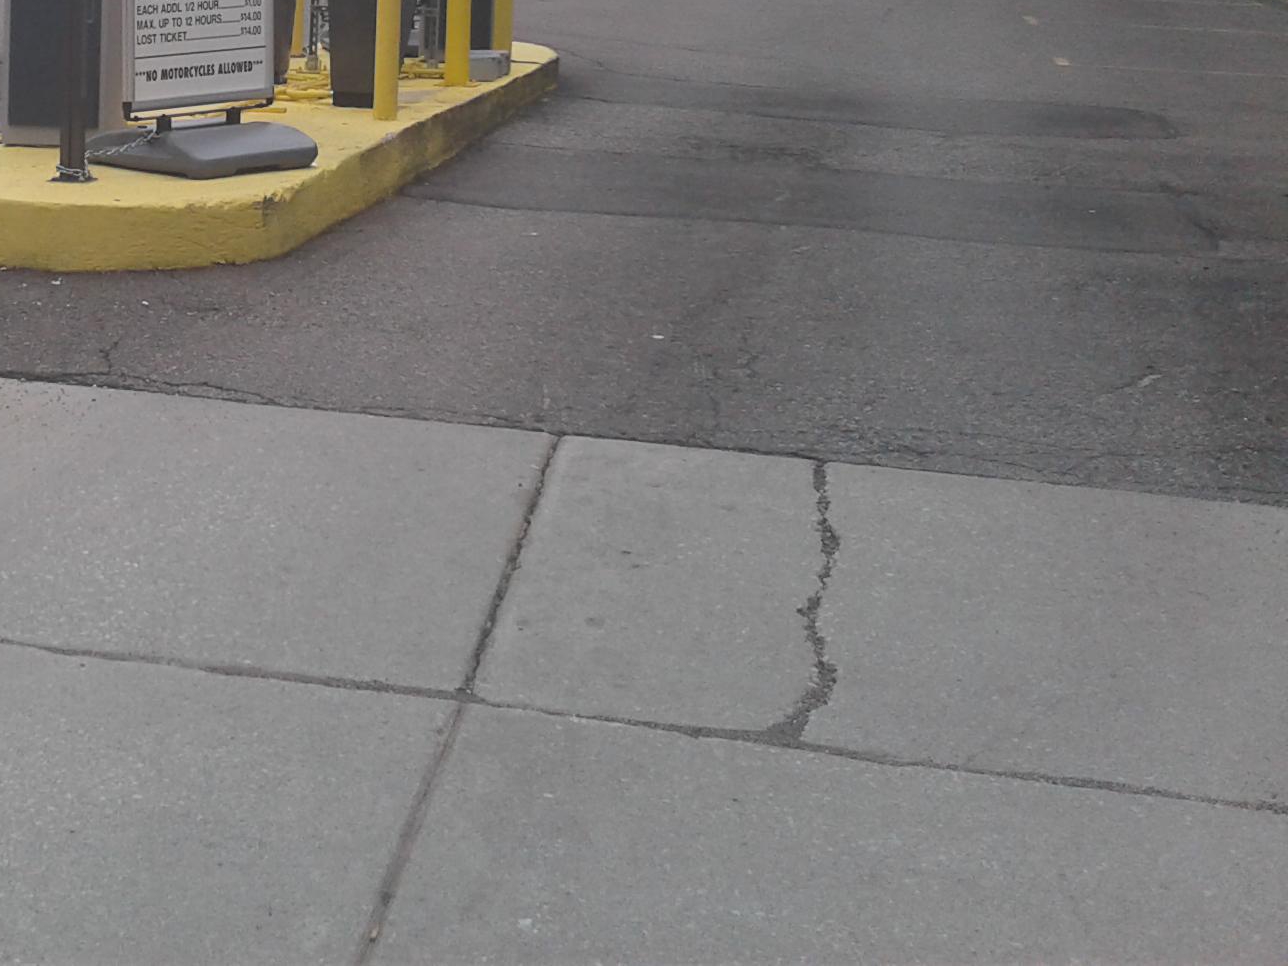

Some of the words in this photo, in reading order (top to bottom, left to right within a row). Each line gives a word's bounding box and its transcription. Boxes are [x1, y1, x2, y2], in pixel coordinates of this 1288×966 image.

[136, 4, 159, 15] EACH
[161, 3, 182, 14] ADDL
[185, 1, 195, 11] 1/2
[197, 0, 219, 10] HOUR
[158, 18, 169, 29] UP
[172, 16, 183, 27] TO
[185, 16, 193, 26] 12
[195, 14, 222, 25] HOURS
[136, 34, 157, 45] LOST
[160, 31, 187, 43] TICKET
[160, 64, 215, 80] MOTORCYCLES
